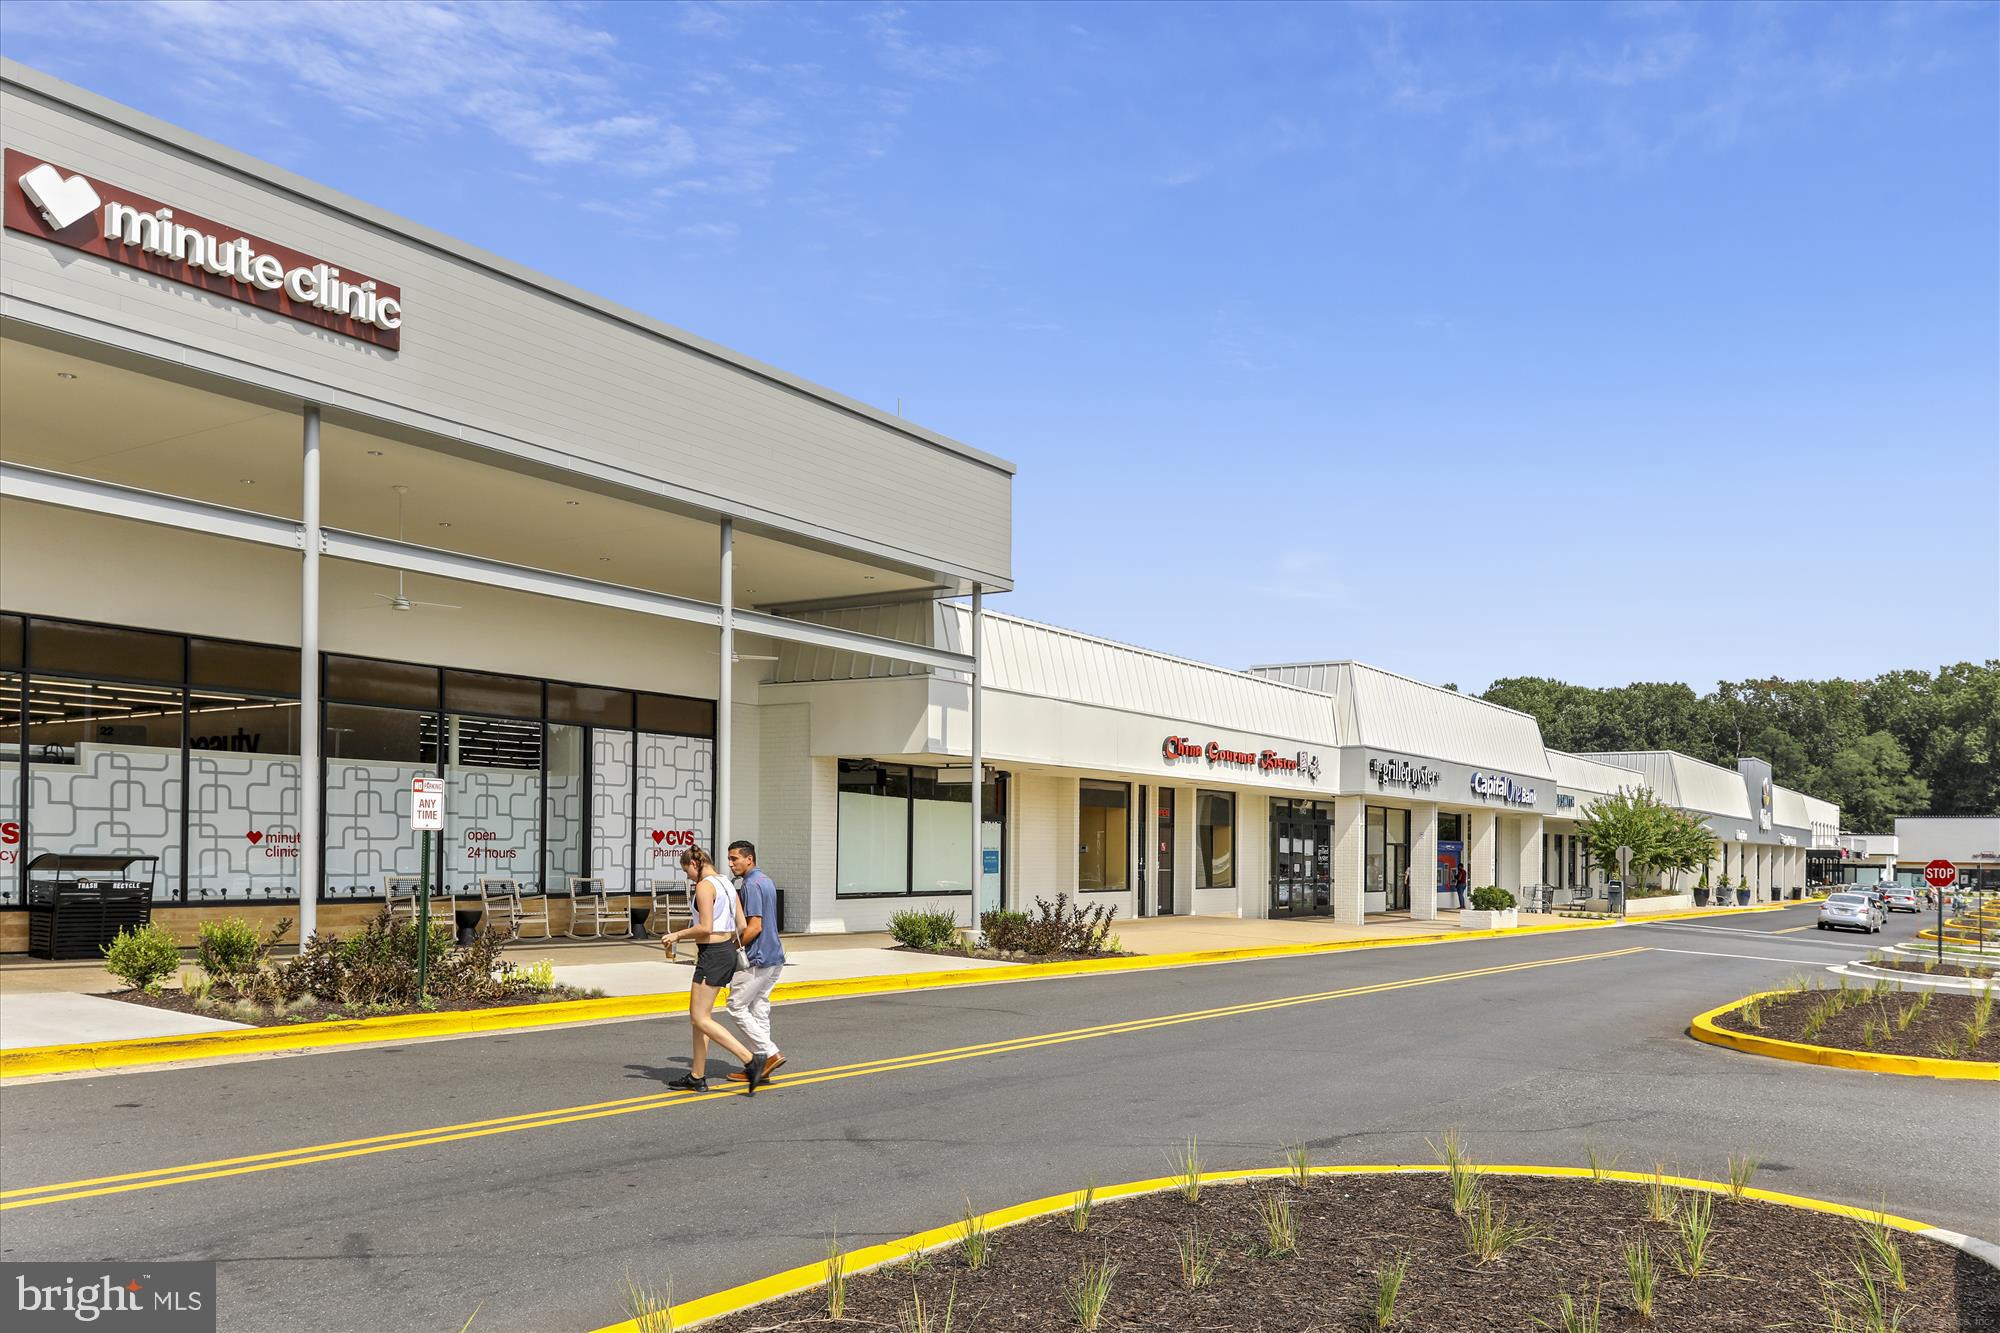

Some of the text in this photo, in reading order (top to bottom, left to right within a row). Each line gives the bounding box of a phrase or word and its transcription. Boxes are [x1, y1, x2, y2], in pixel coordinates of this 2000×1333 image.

[105, 201, 402, 331] minute clinic
[1205, 741, 1257, 764] Gourmet
[1258, 749, 1297, 771] Bistro
[1379, 759, 1411, 784] grilled
[1411, 765, 1435, 790] oyster
[423, 782, 442, 790] PARKING
[1471, 771, 1507, 799] Capital
[1521, 789, 1537, 804] Bank
[419, 799, 437, 808] ANY
[417, 810, 438, 820] TIME
[265, 831, 301, 844] minut
[468, 831, 497, 843] open
[665, 830, 695, 846] CVS
[265, 845, 298, 858] clinic
[467, 846, 517, 859] 24 hours
[1926, 867, 1954, 879] STOP
